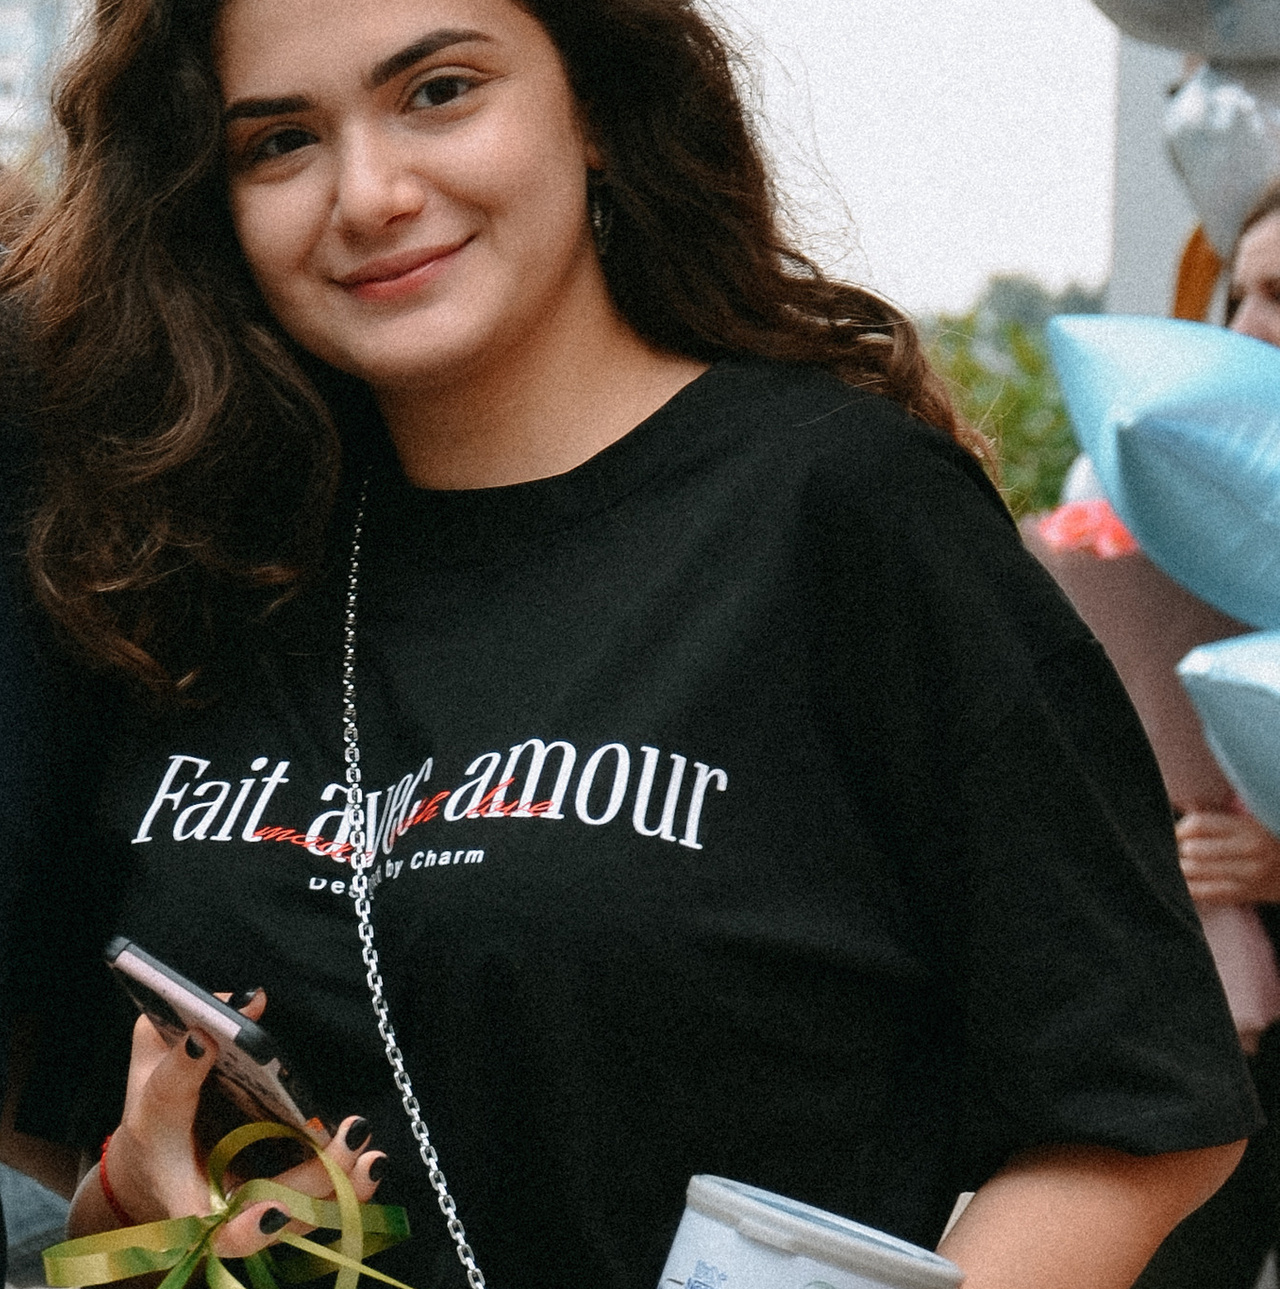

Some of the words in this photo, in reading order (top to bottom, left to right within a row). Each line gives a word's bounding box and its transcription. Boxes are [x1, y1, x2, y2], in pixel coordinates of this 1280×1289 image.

[131, 755, 290, 844] Fait
[444, 738, 728, 850] amour
[385, 859, 404, 879] by
[410, 849, 485, 870] Charm
